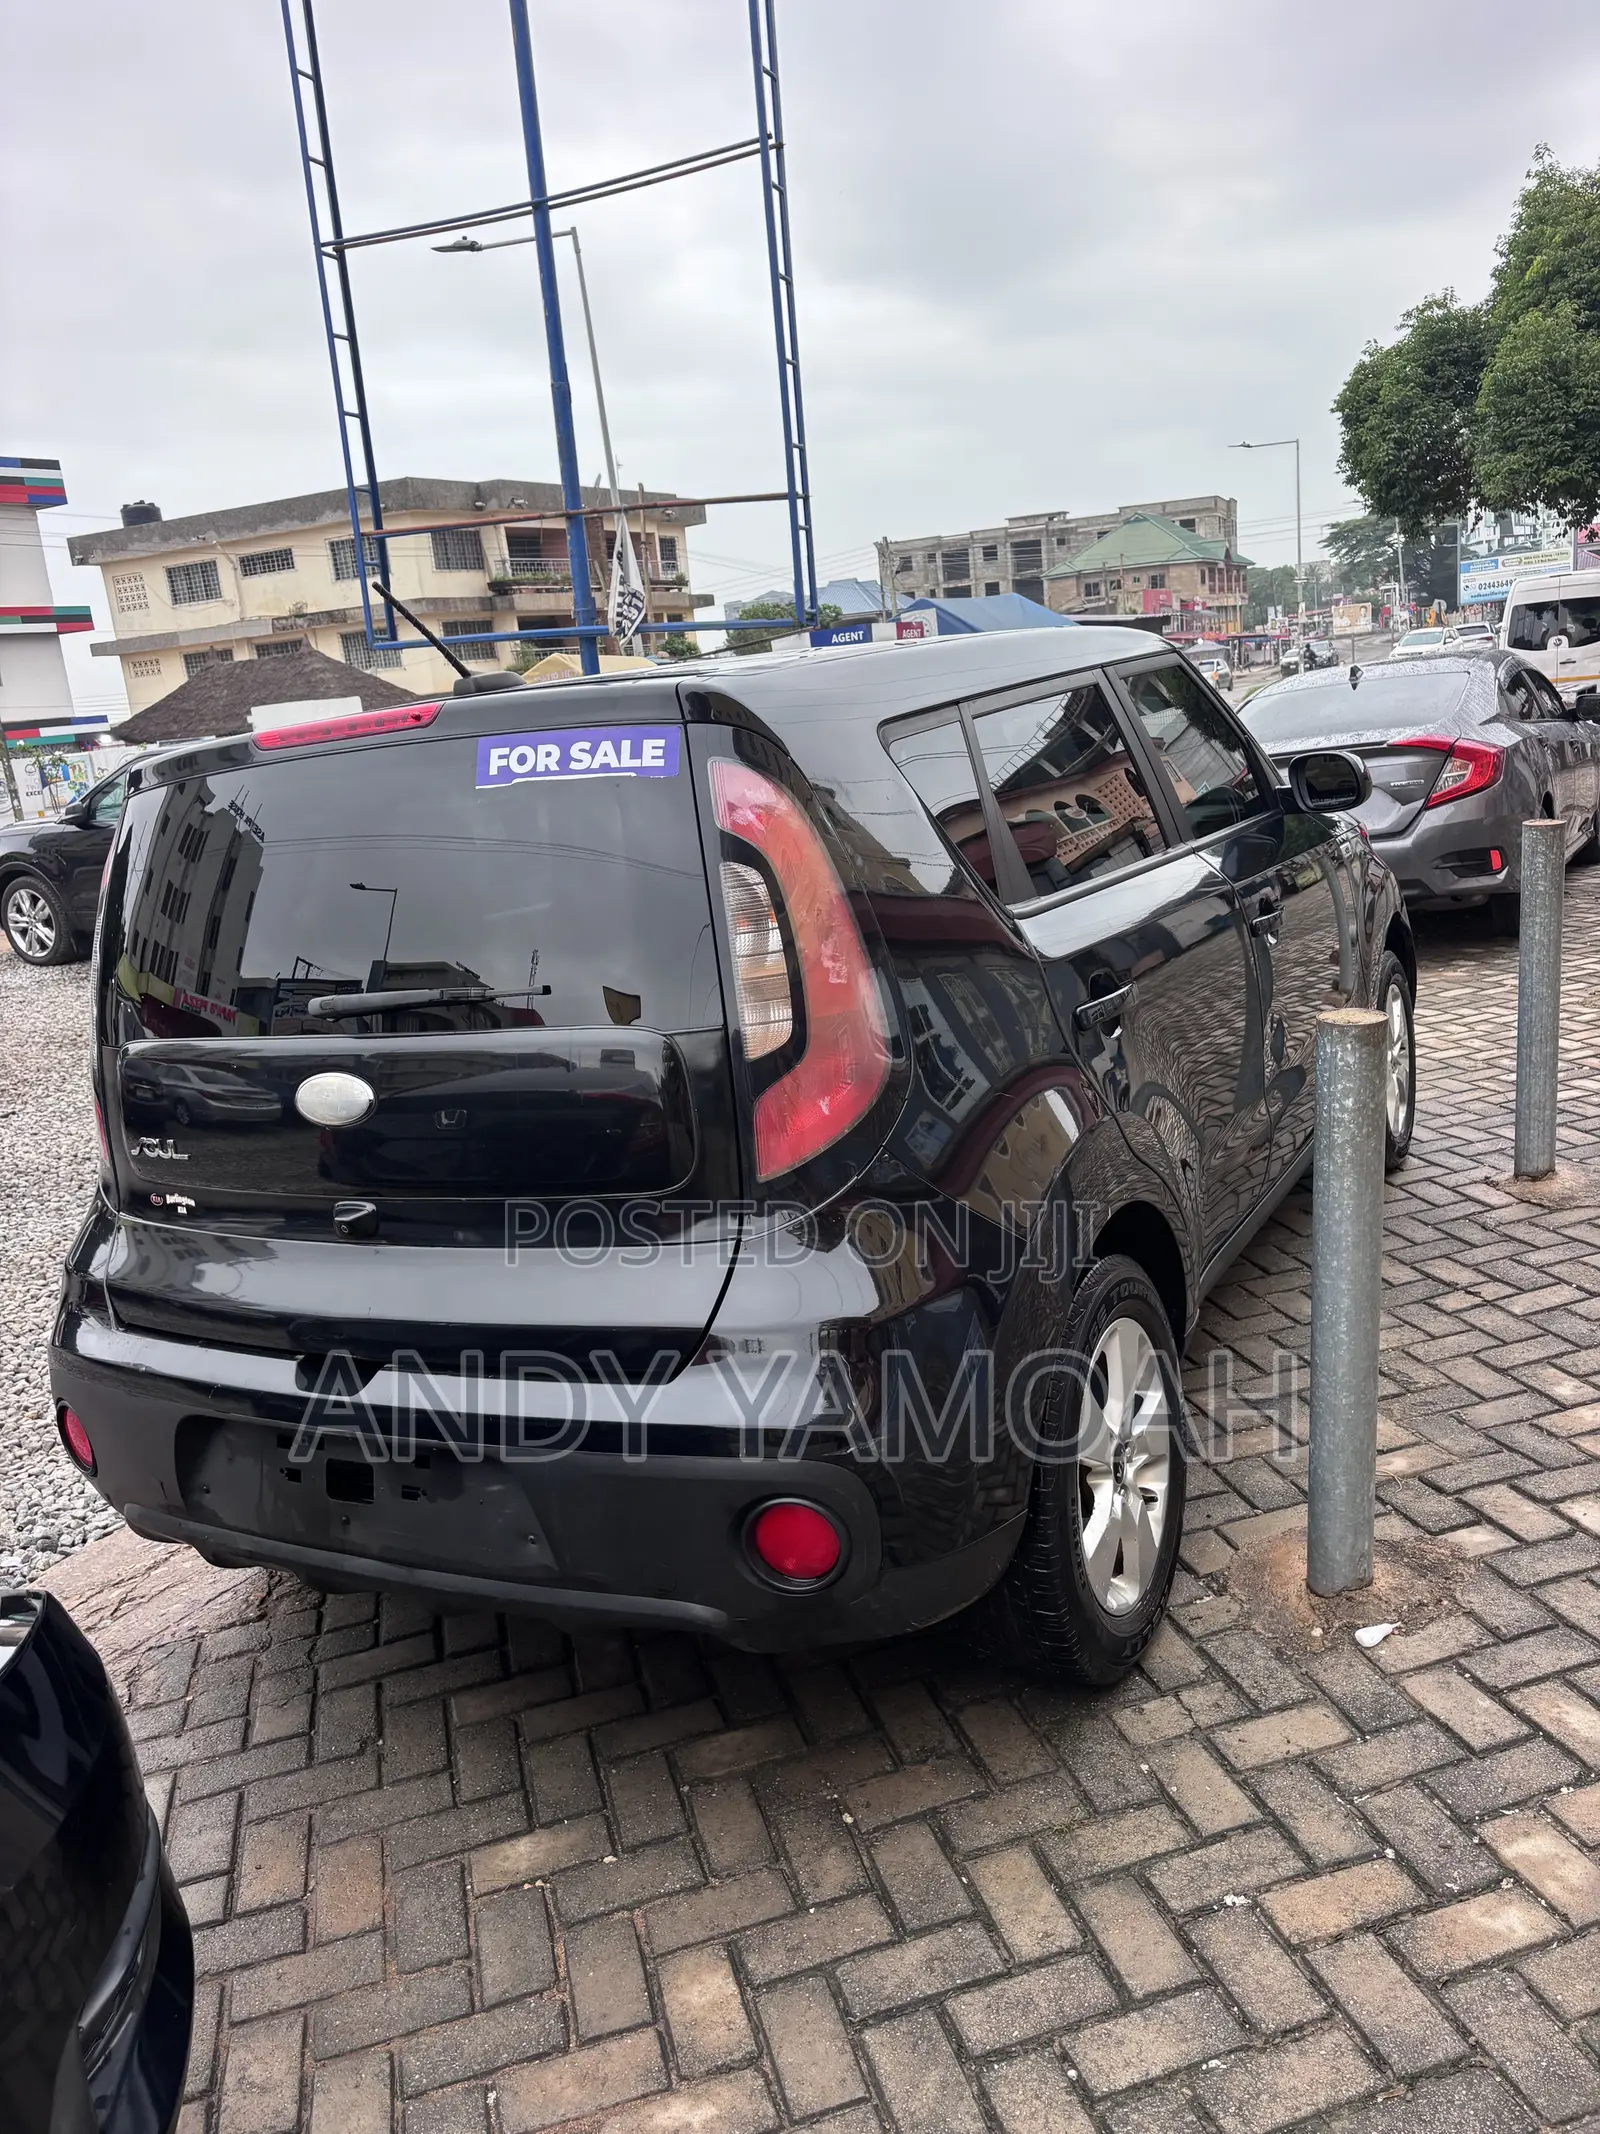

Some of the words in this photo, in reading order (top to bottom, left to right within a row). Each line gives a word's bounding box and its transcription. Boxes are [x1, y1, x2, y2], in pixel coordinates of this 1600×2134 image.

[831, 631, 864, 644] AGENT
[902, 628, 921, 638] AGENT
[489, 744, 560, 775] FOR
[569, 739, 665, 770] SALE
[130, 1136, 190, 1160] SOUL
